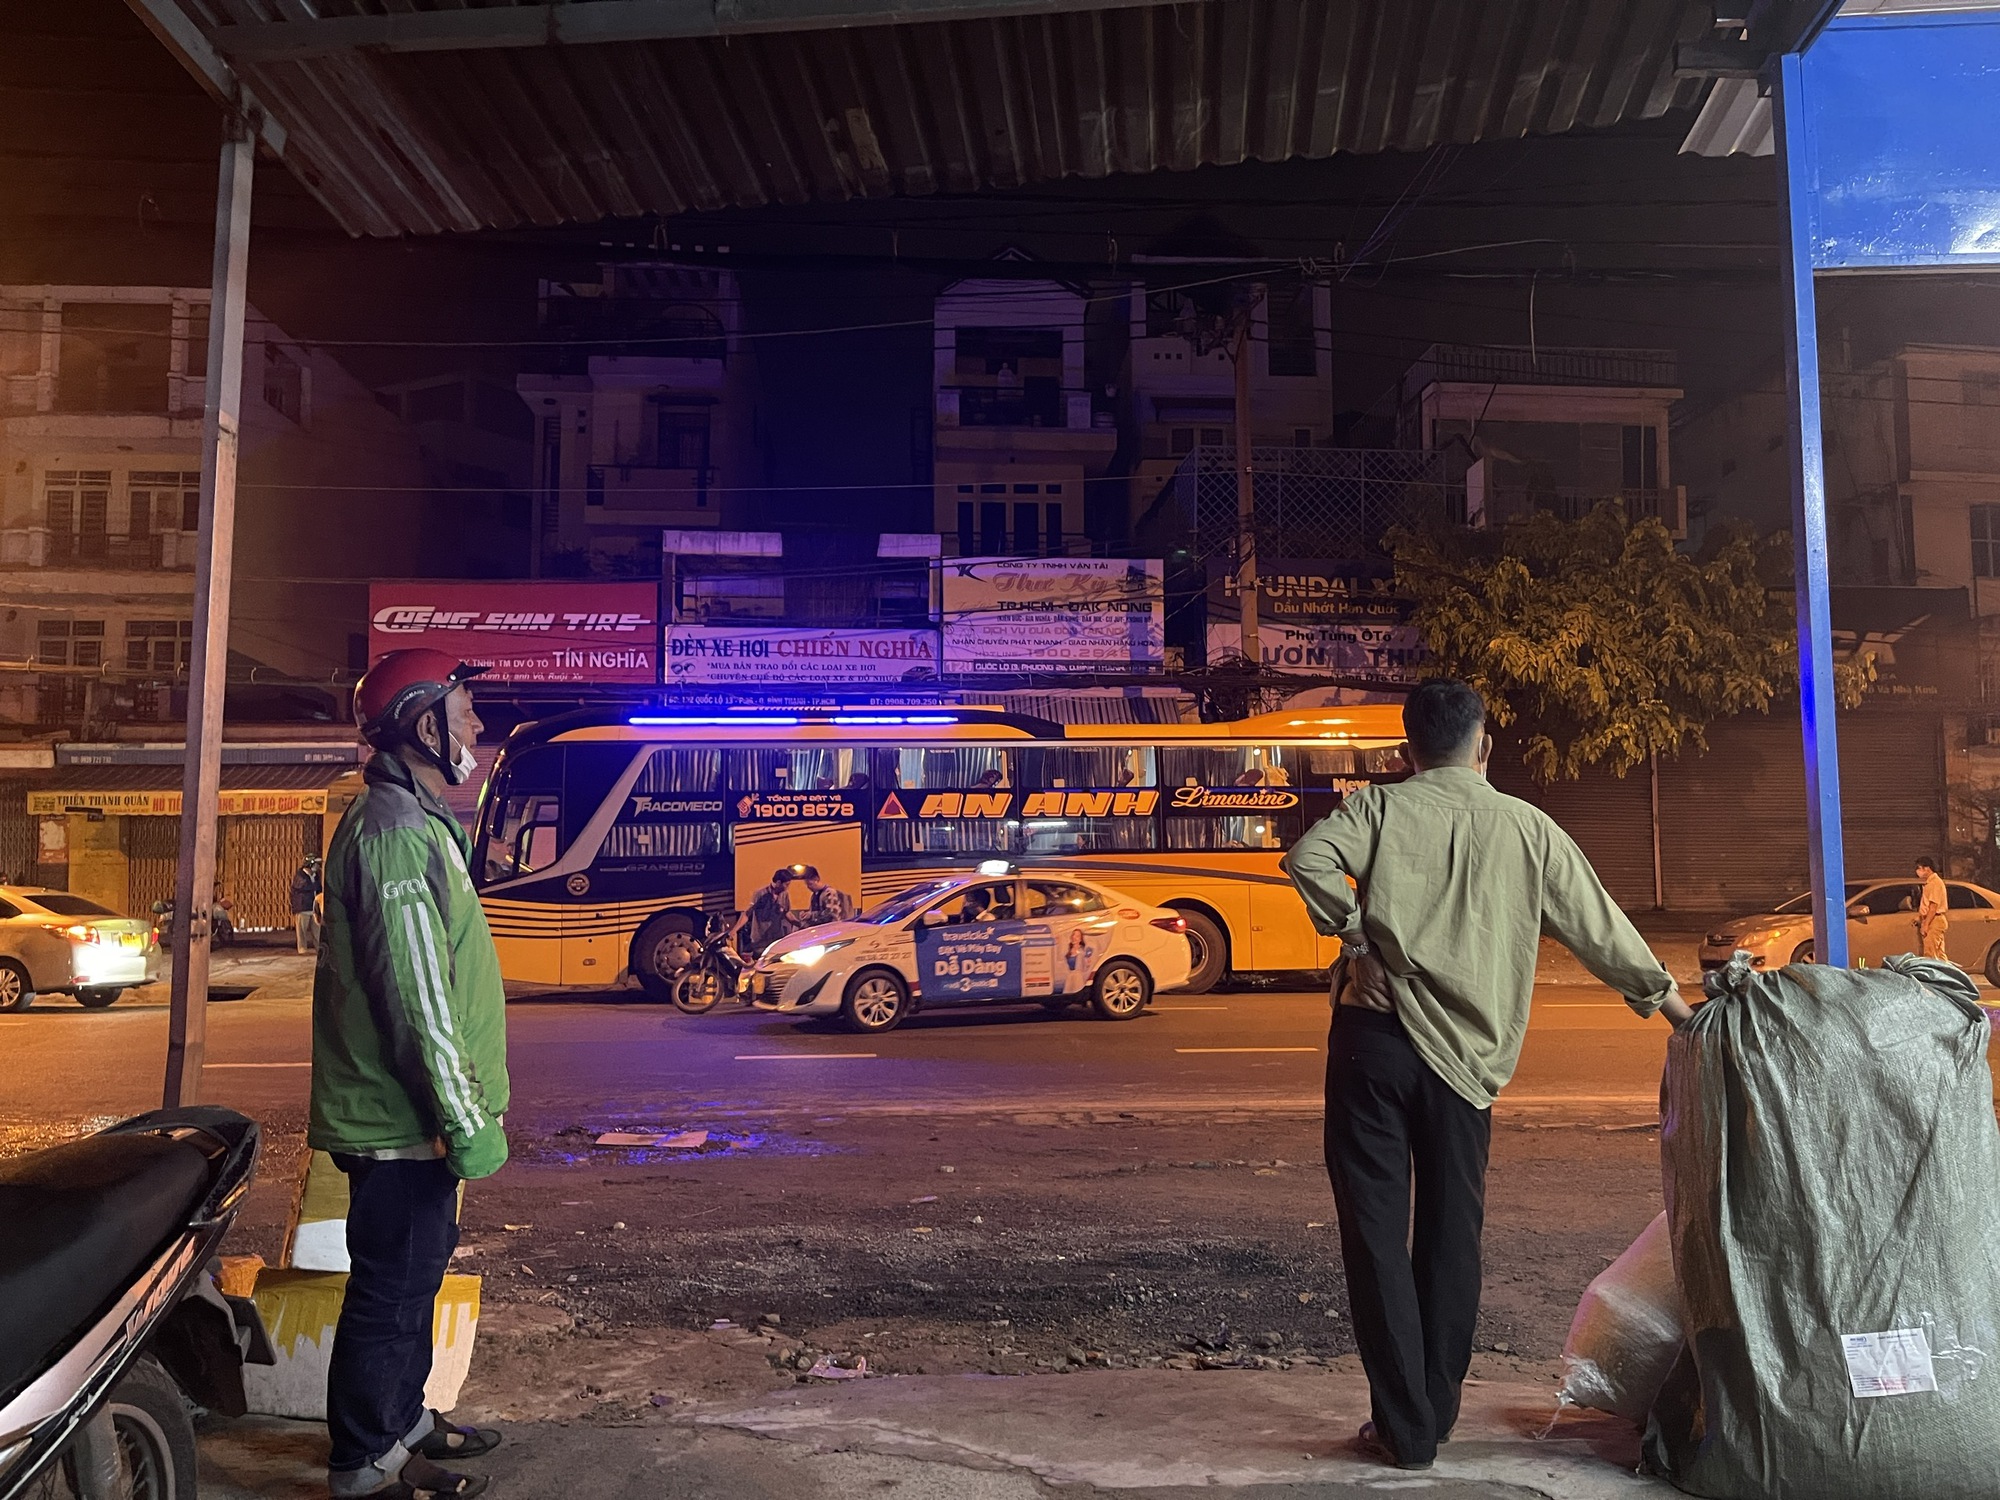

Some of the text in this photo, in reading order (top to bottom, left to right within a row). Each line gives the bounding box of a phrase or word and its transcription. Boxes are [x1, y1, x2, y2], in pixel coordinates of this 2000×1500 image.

[1224, 576, 1358, 598] HUNDAI
[1302, 601, 1335, 613] Nhớt
[473, 612, 556, 631] SHIN
[563, 612, 651, 631] TIRE
[671, 631, 932, 659] ĐÈN XE HƠI CHIẾN NGHĨA
[1285, 630, 1314, 644] Phụ
[1319, 630, 1357, 644] Tùng
[499, 659, 511, 668] TM
[514, 659, 525, 668] DV
[553, 647, 583, 668] TÍN
[589, 648, 649, 668] NGHĨA
[755, 663, 779, 671] TRAO
[845, 663, 858, 671] XE
[631, 797, 722, 818] TRACOMECO
[919, 790, 1160, 818] AN ANH
[1171, 786, 1298, 809] Limousine
[754, 803, 854, 817] 1900 8678
[962, 958, 1007, 977] Dàng
